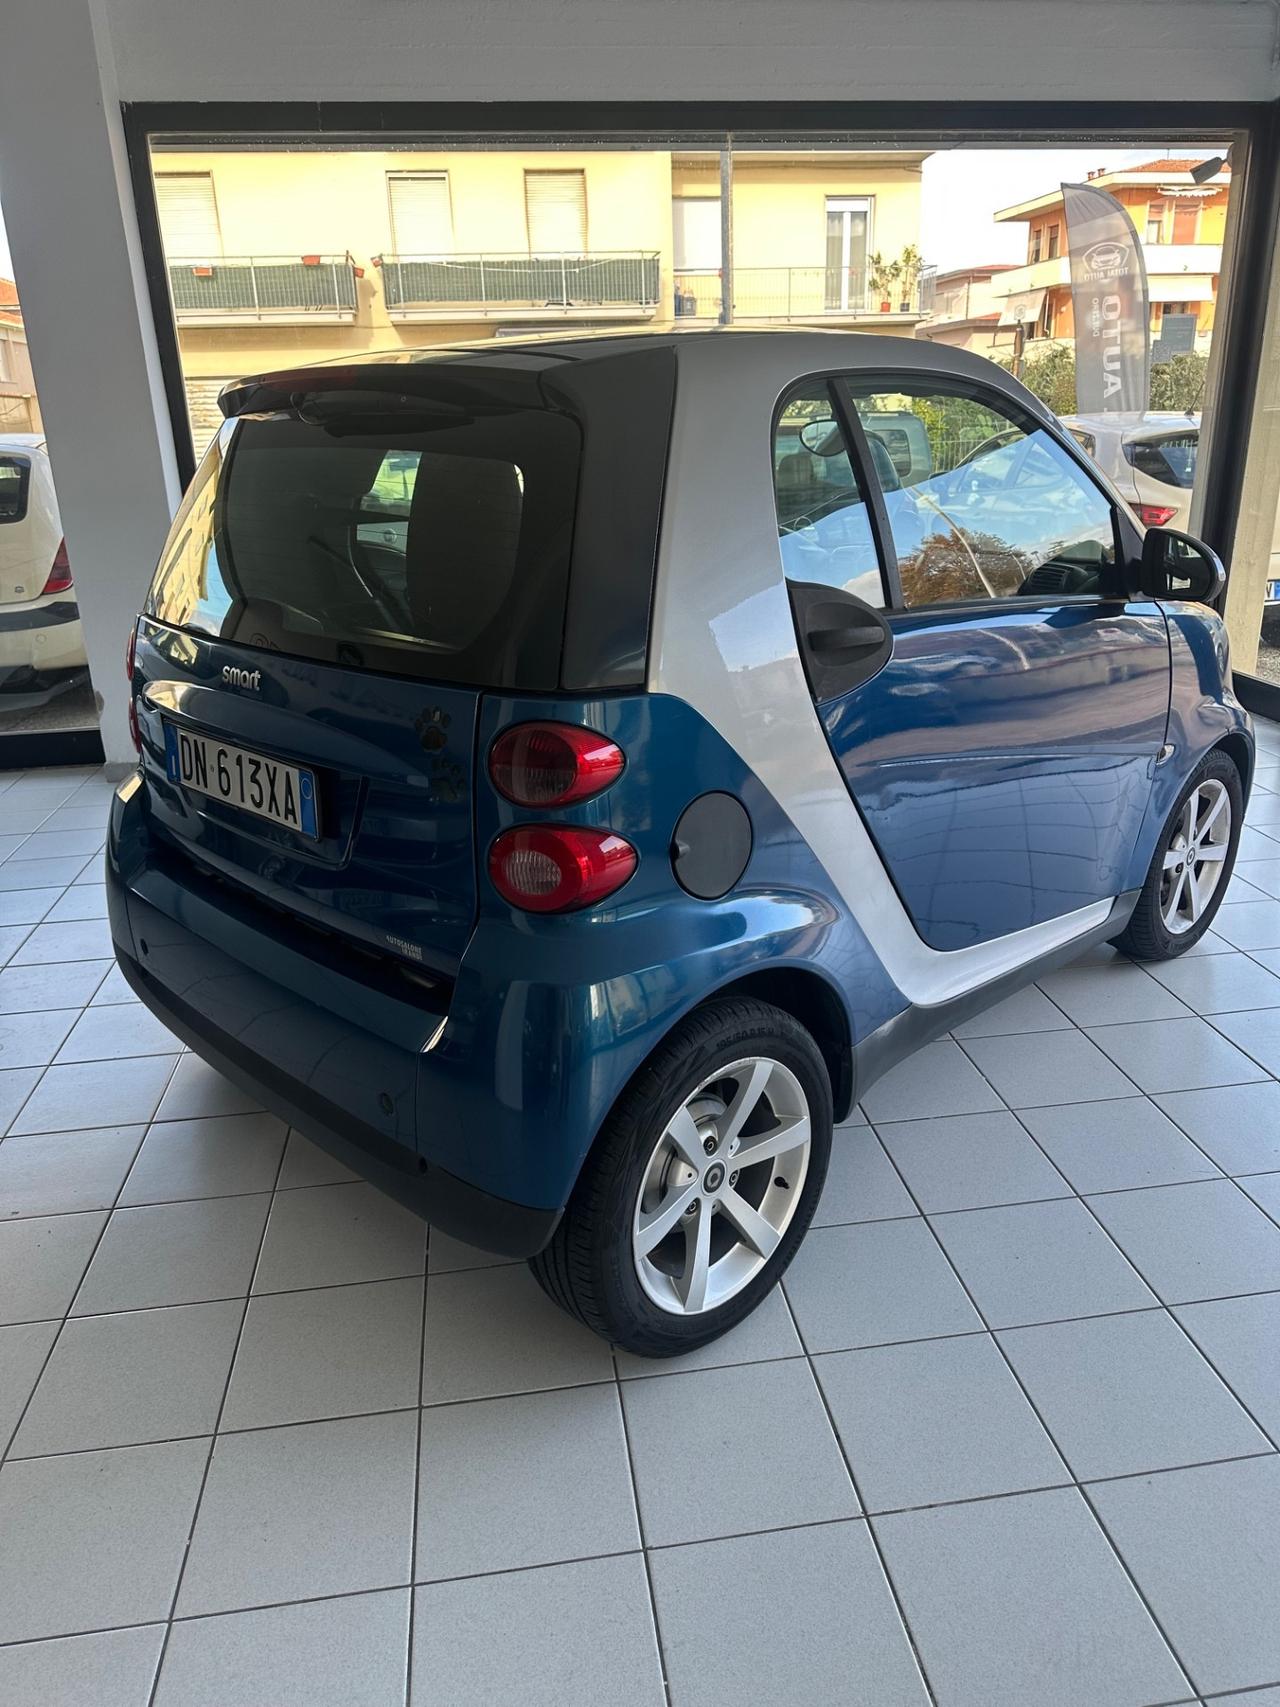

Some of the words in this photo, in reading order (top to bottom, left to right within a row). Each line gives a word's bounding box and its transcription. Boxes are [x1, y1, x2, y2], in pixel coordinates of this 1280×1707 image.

[222, 664, 261, 692] smart
[179, 733, 208, 789] DN
[216, 747, 298, 825] 613XA
